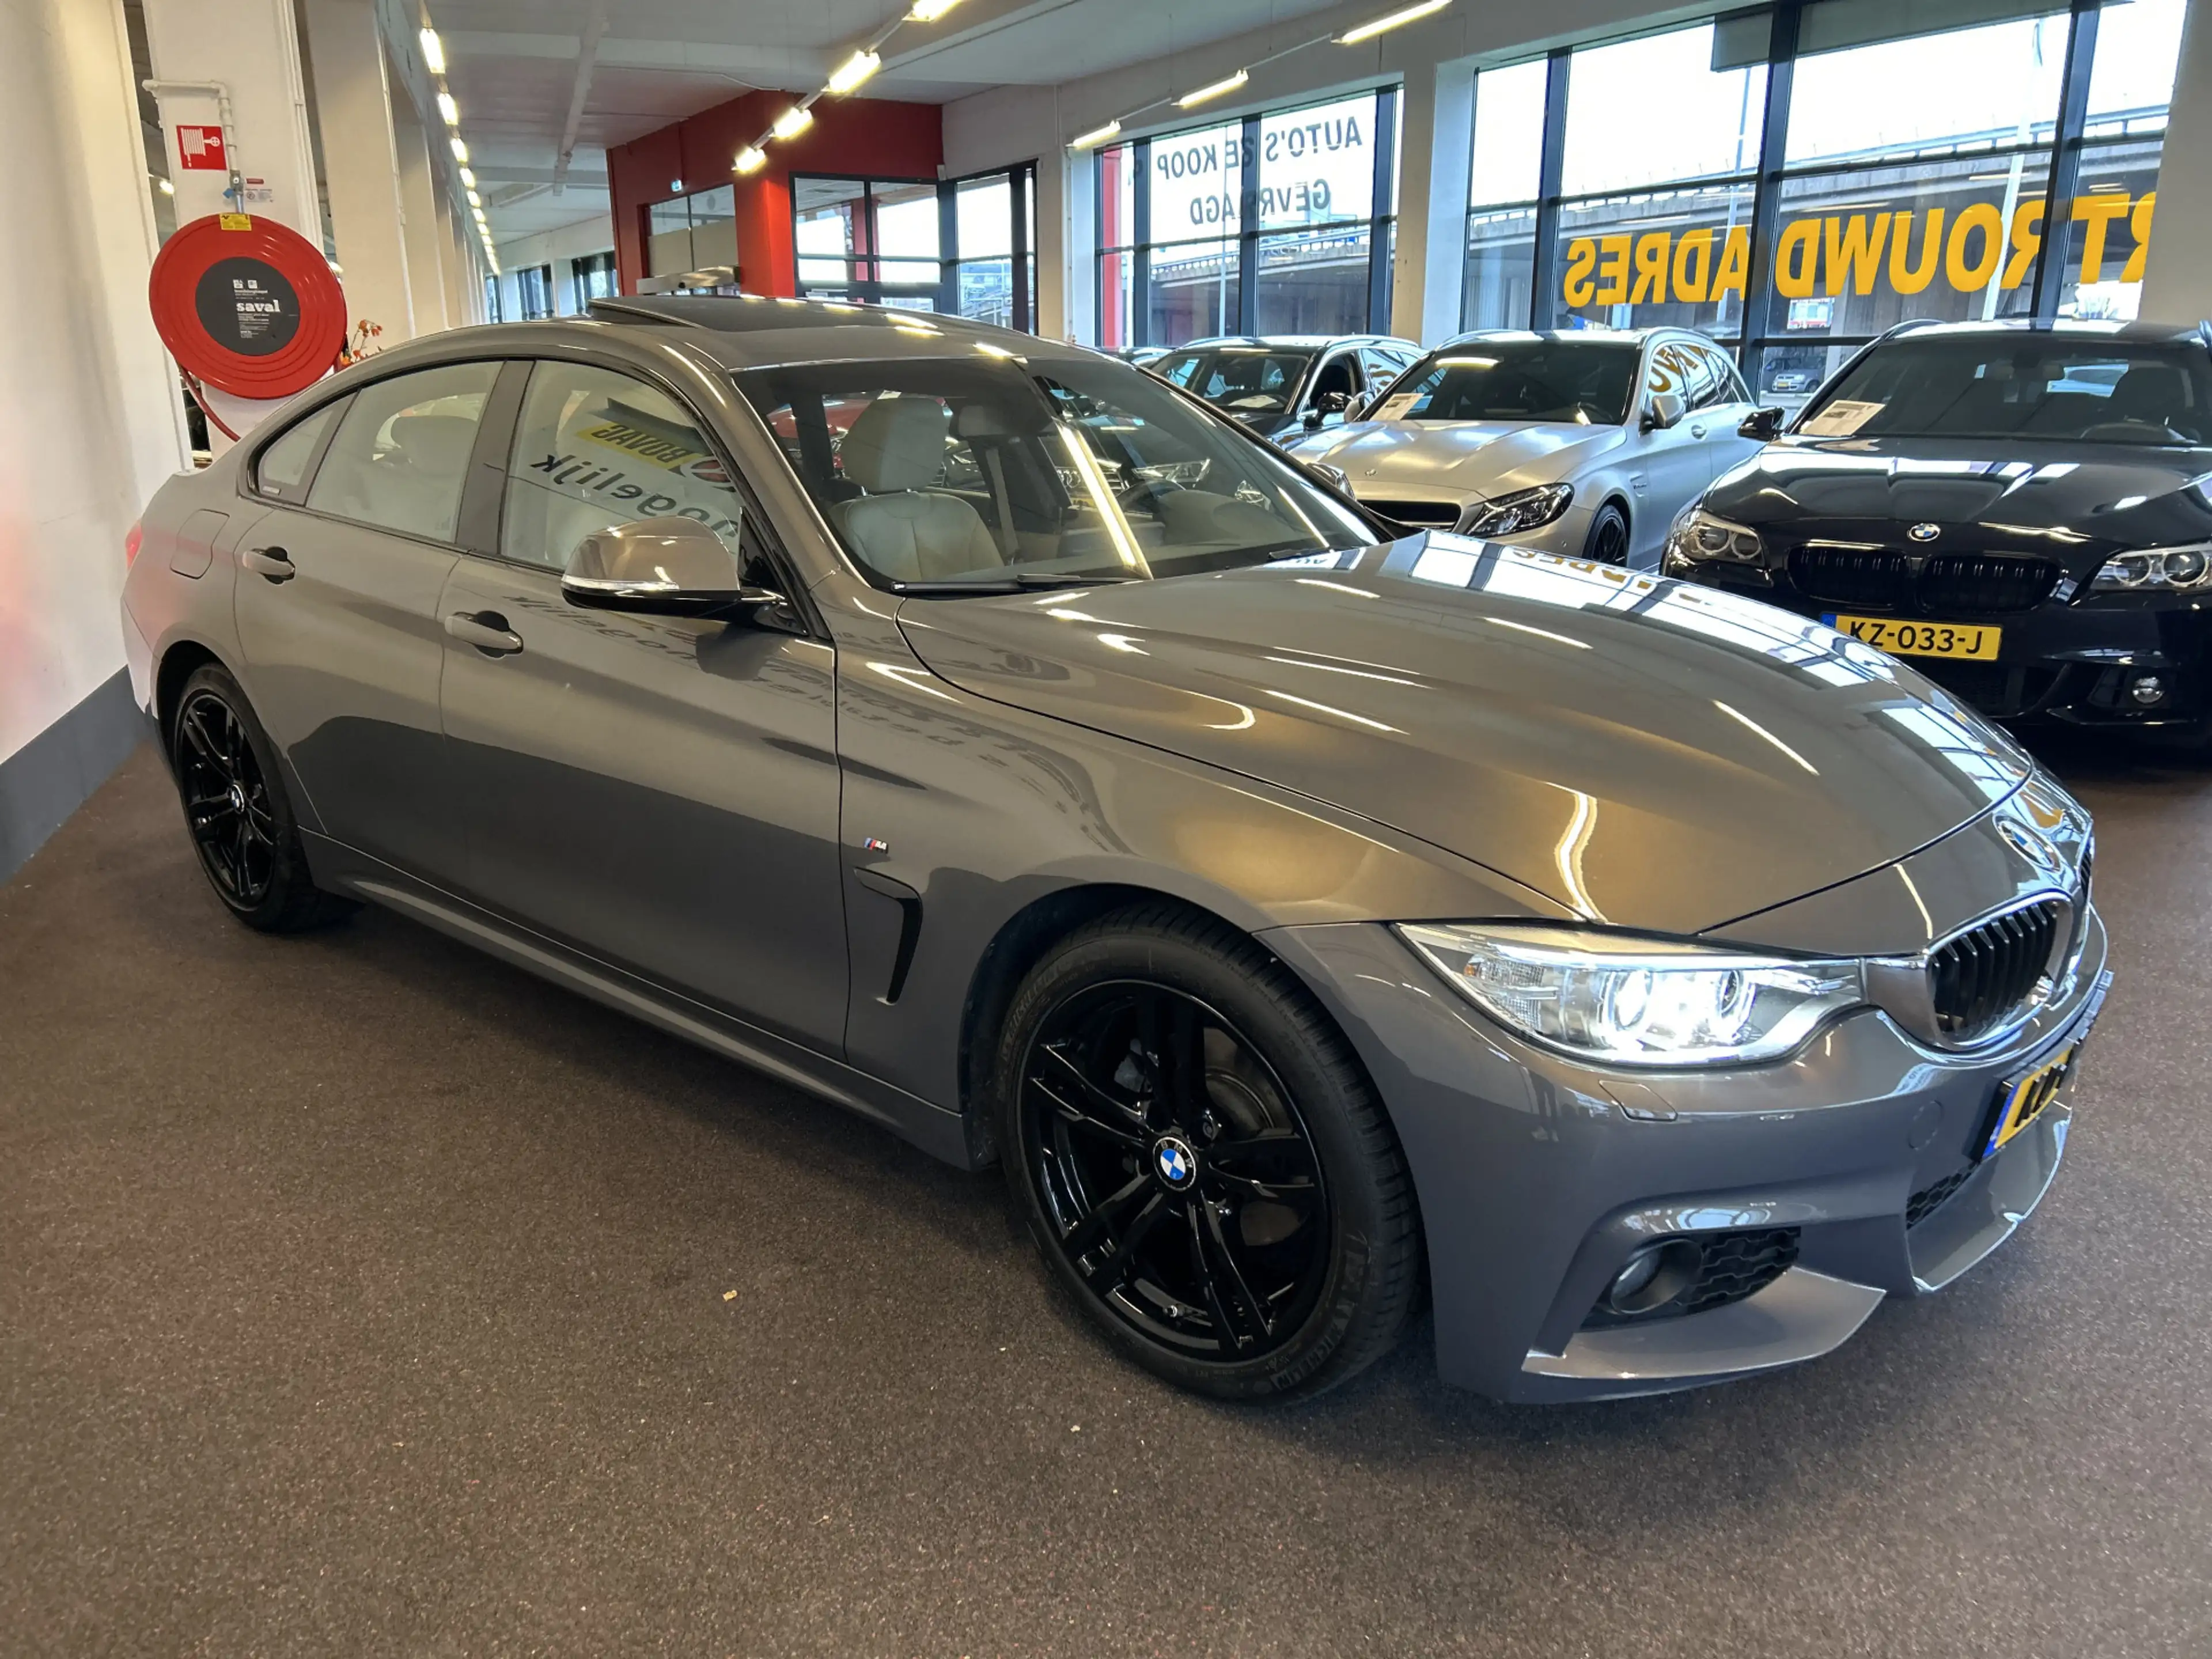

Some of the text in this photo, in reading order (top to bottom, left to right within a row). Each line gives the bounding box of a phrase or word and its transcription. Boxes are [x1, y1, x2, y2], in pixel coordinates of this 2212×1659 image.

[236, 299, 281, 312] saval
[1850, 620, 1983, 654] KZ-033-J
[1160, 1139, 1194, 1168] BMW
